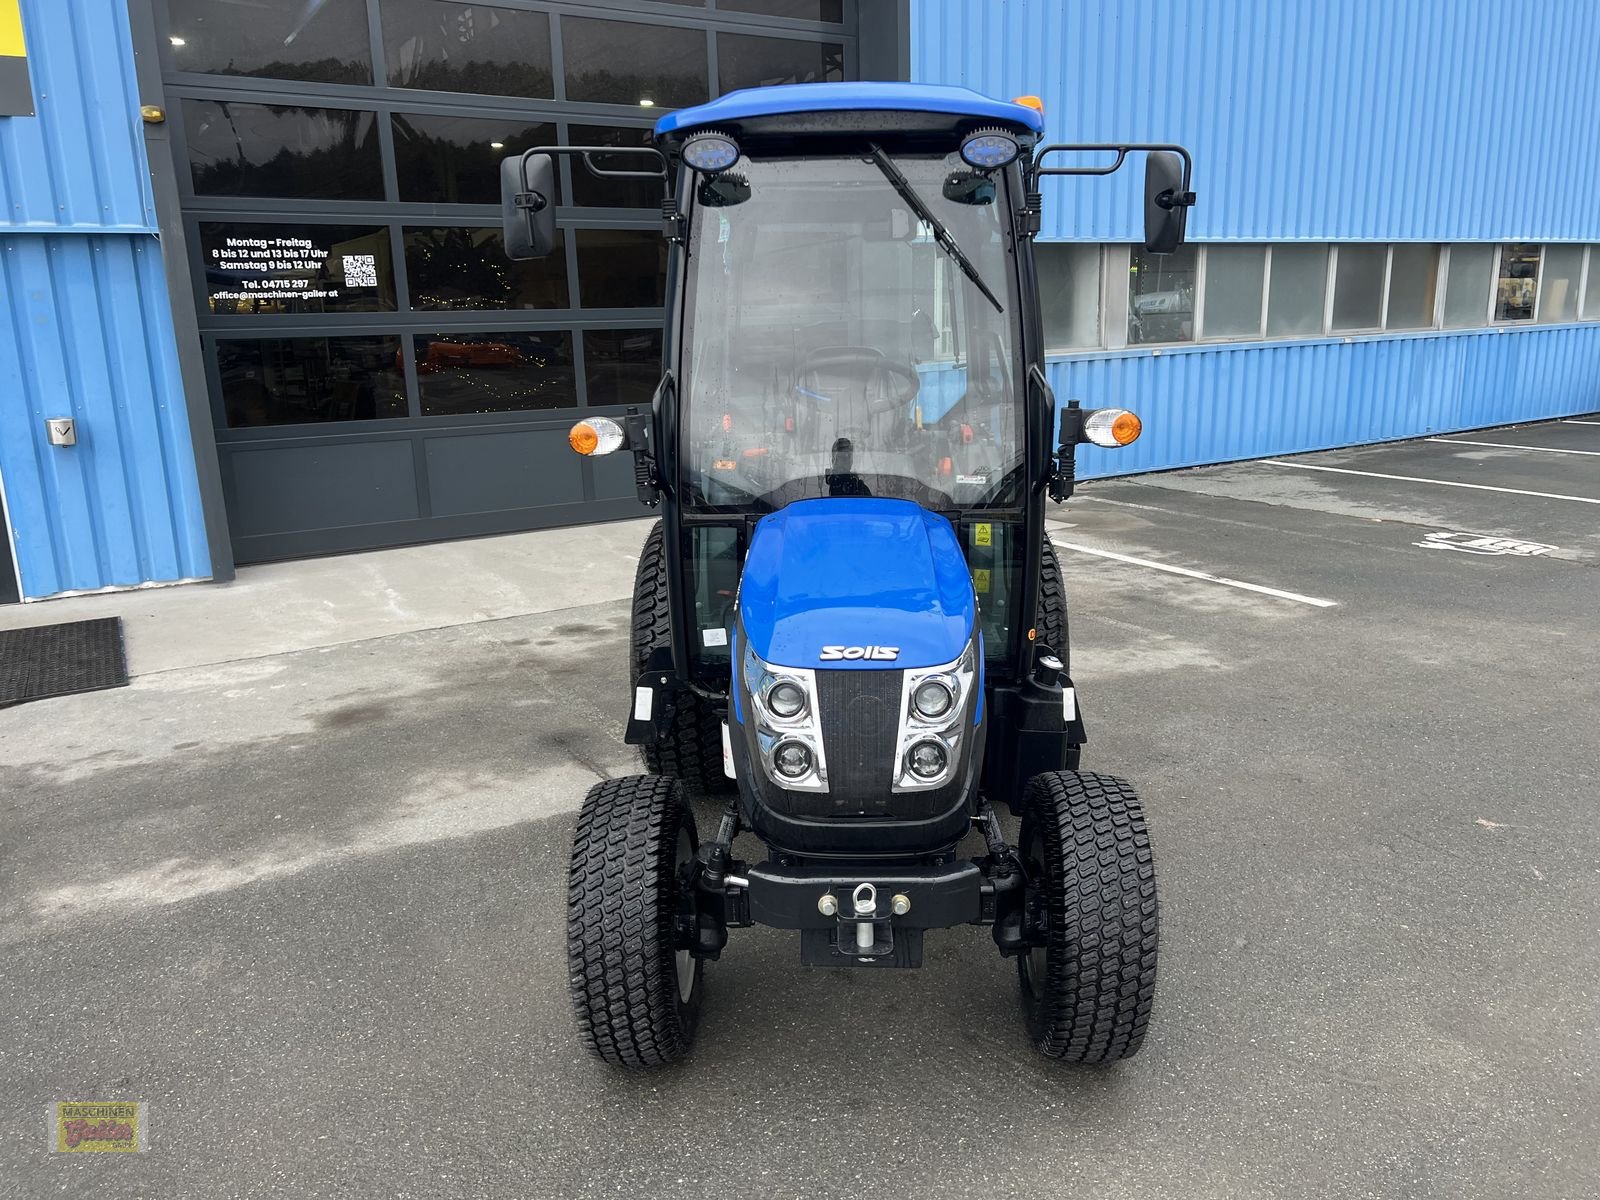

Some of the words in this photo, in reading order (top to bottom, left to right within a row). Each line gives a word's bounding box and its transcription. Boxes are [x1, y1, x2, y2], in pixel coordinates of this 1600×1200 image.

[226, 238, 267, 249] Montag
[276, 238, 312, 249] Freitag
[212, 250, 219, 258] 8
[221, 250, 237, 258] bis
[238, 250, 249, 258] 12
[250, 250, 270, 258] und
[272, 250, 282, 258] 13
[283, 250, 299, 258] bis
[300, 250, 309, 258] 17
[312, 250, 329, 258] Uhr
[220, 261, 267, 272] Samstag
[269, 261, 275, 269] 9
[276, 261, 292, 270] bis
[294, 261, 303, 269] 12
[304, 261, 322, 270] Uhr
[242, 280, 261, 289] Tel.
[261, 280, 291, 289] 04715
[292, 280, 309, 288] 297
